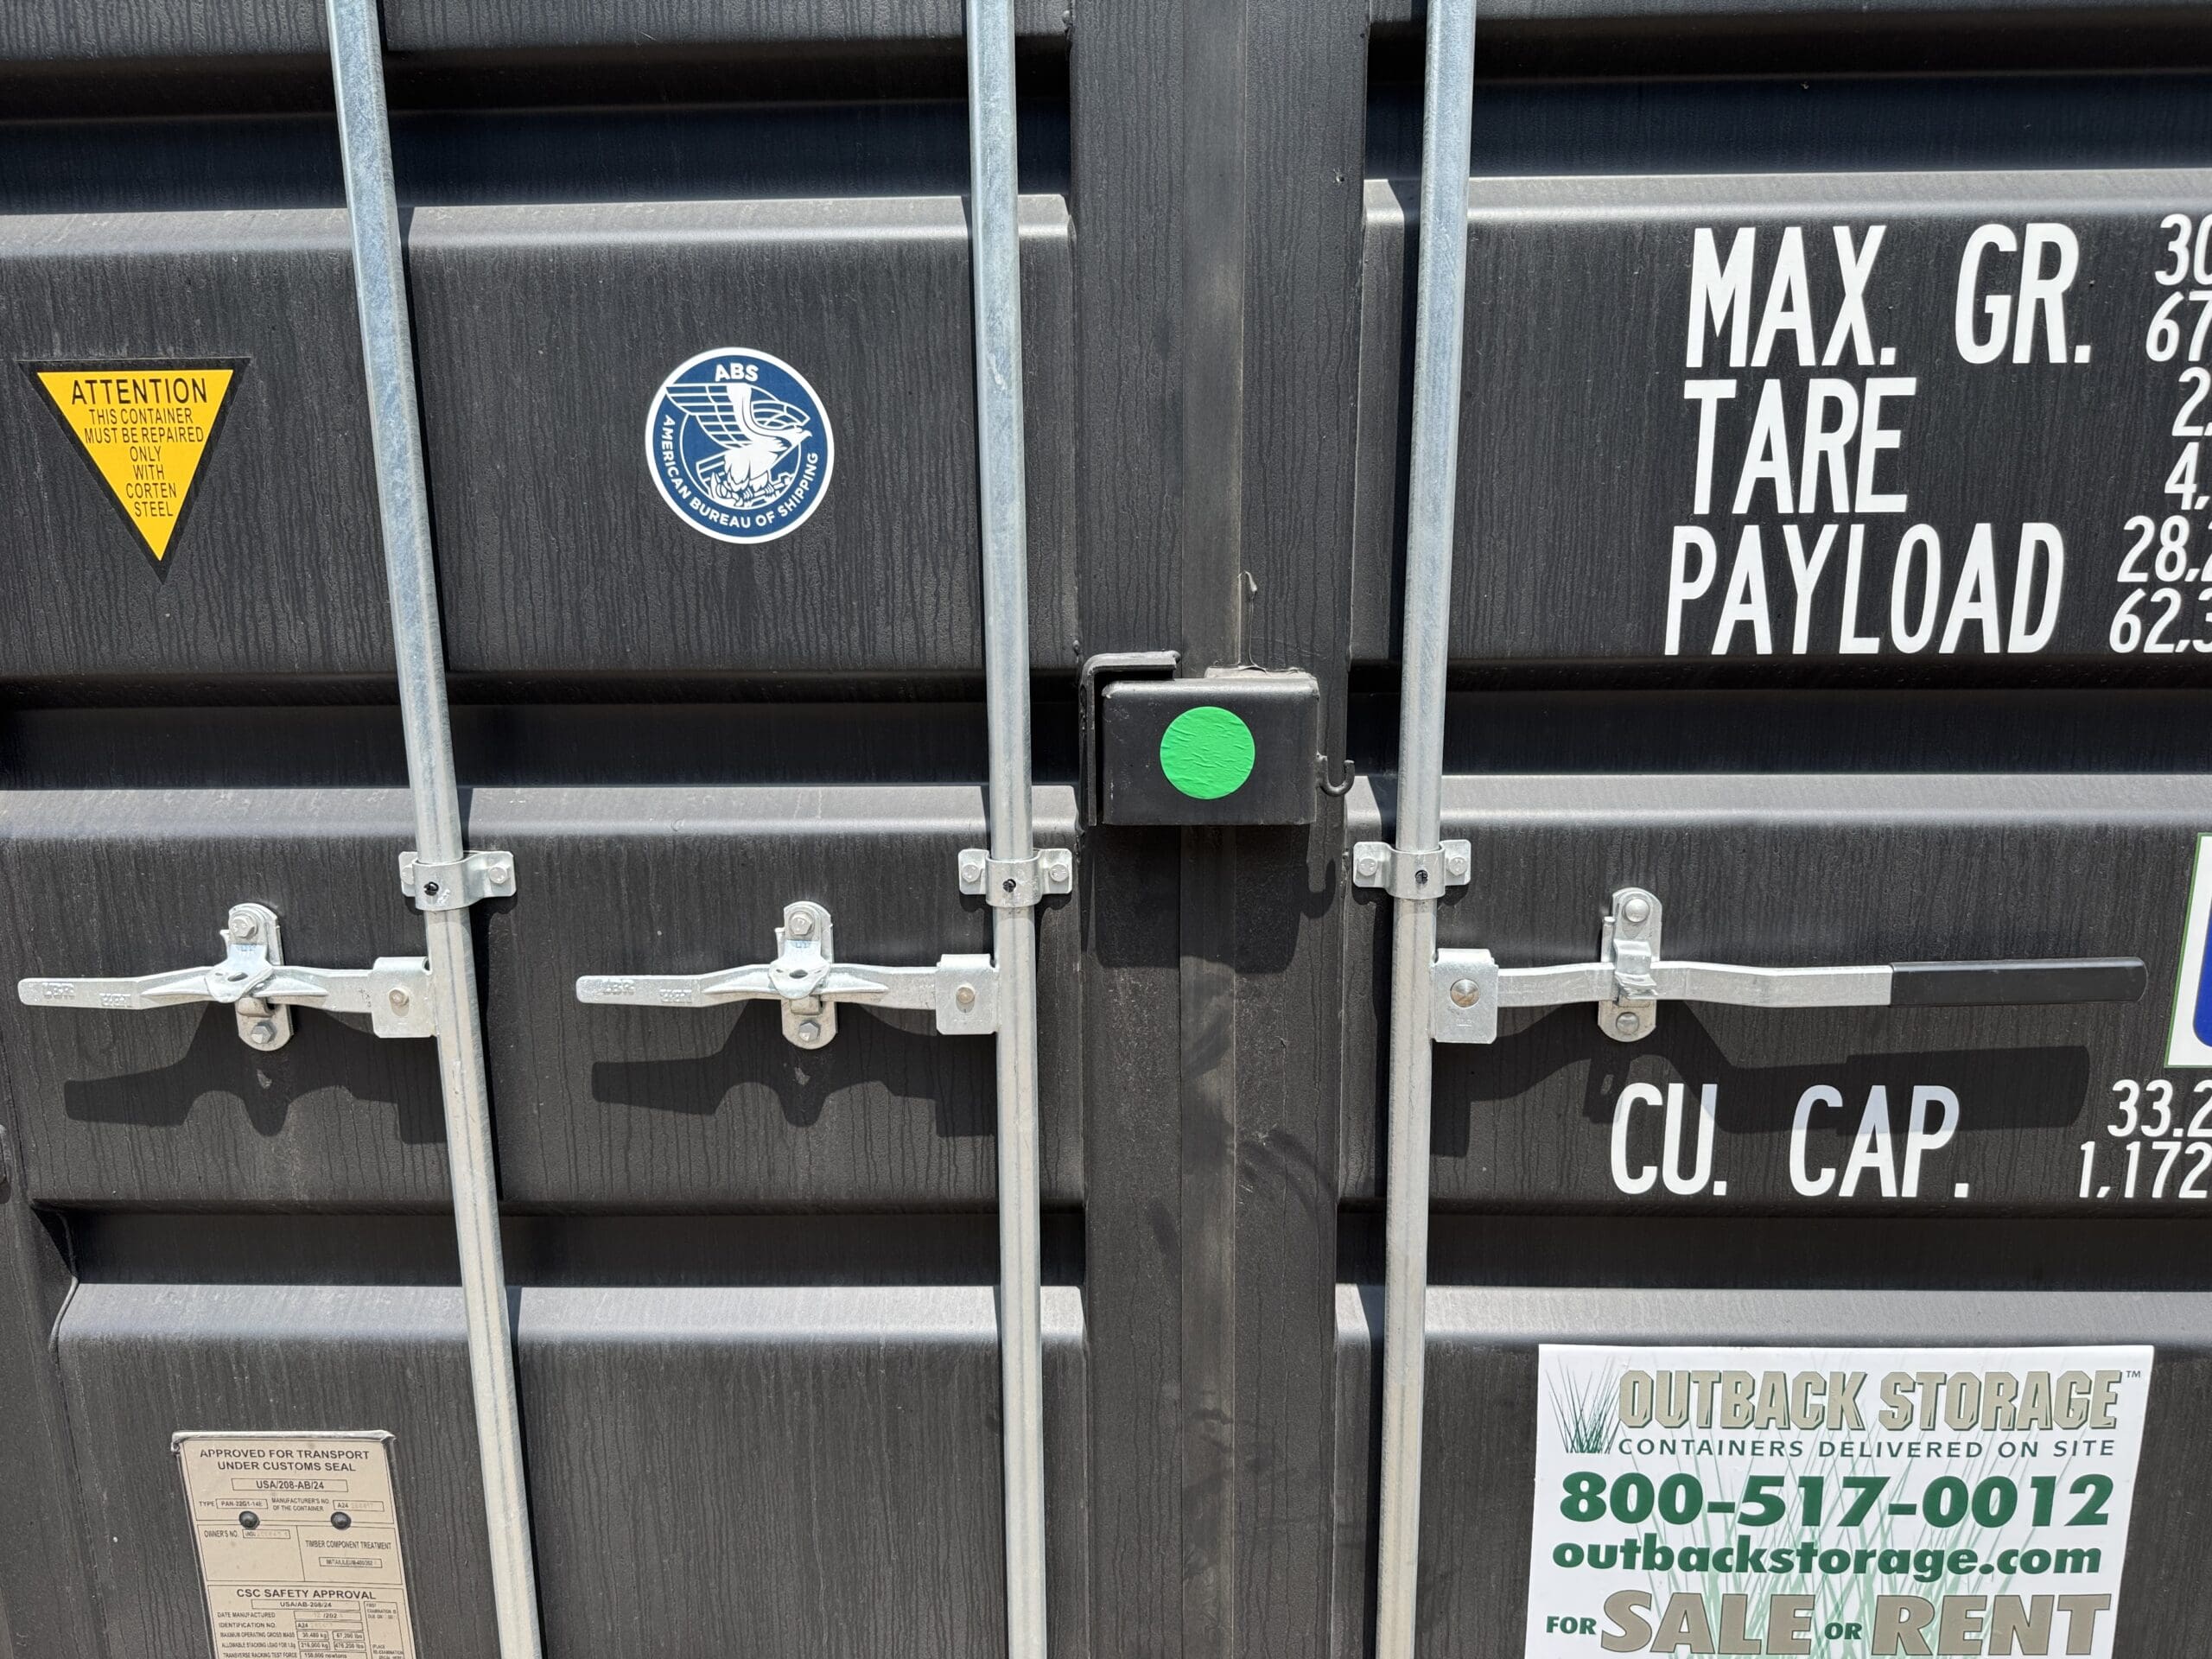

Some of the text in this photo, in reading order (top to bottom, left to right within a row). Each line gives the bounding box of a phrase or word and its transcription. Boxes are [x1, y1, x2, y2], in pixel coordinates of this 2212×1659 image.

[1686, 222, 2091, 368] MAX. GR.
[715, 362, 759, 382] ABS
[72, 378, 207, 404] ATTENTION
[89, 408, 194, 425] THIS CONTAINER
[85, 426, 204, 444] MUST BE REPAIRED
[130, 446, 162, 461] ONLY
[1684, 377, 1916, 514] TARE
[133, 464, 164, 480] WITH
[661, 414, 819, 529] AMERICAN BUREAU OF SHIPPING
[125, 482, 177, 499] CORTEN
[134, 501, 174, 518] STEEL
[1664, 522, 2064, 656] PAYLOAD
[1610, 1082, 1969, 1198] CU. CAP.
[2079, 1141, 2212, 1198] 1,172
[1618, 1370, 1867, 1431] OUTBACK
[1878, 1370, 2123, 1432] STORAGE
[200, 1449, 370, 1459] APPROVED FOR TRANSPORT
[1618, 1439, 2115, 1459] CONTAINERS DELIVERED ON SITE
[218, 1461, 356, 1471] UNDER CUSTOMS SEAL
[256, 1479, 324, 1490] USA/208-AB/24
[1560, 1471, 2113, 1529] 800-517-0012
[326, 1541, 359, 1549] COMPONENT
[360, 1541, 391, 1550] TREATMENT
[1553, 1533, 2101, 1583] outbackstorage.com
[237, 1588, 377, 1600] CSC SAFETY APPROVAL
[1546, 1590, 2112, 1656] FOR SALE OR RENT
